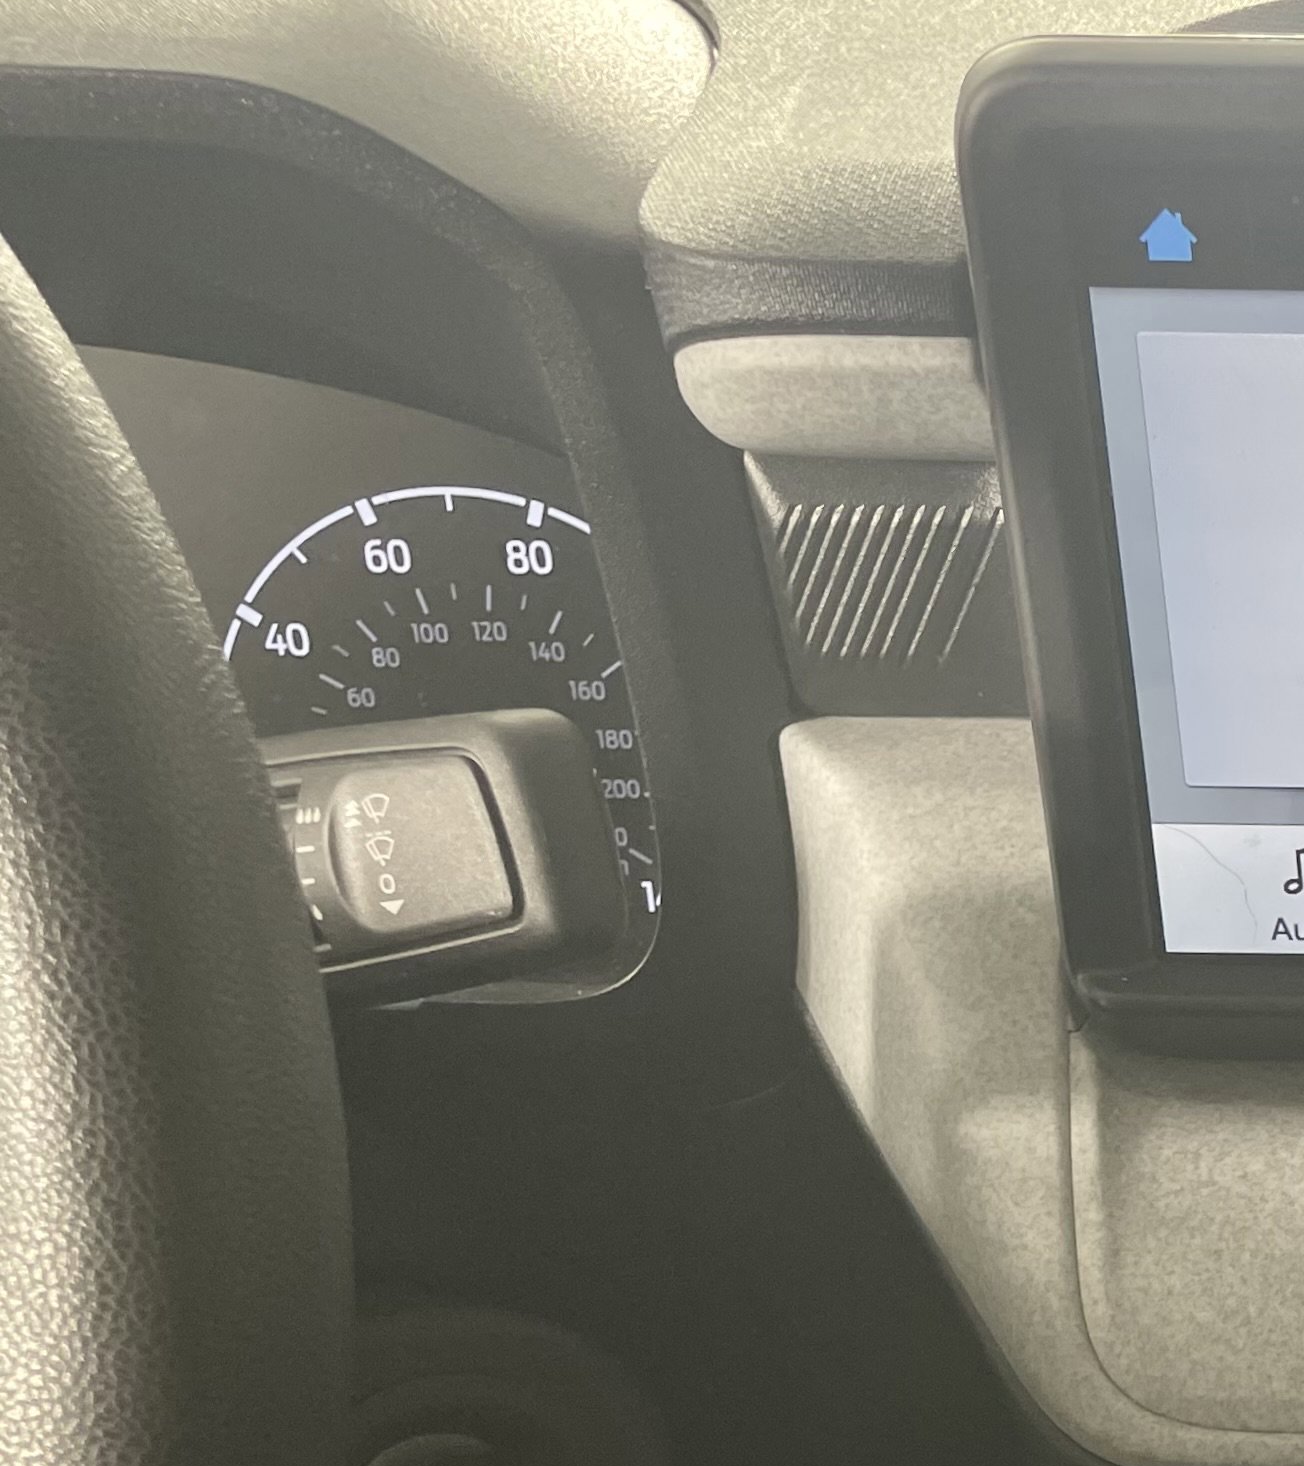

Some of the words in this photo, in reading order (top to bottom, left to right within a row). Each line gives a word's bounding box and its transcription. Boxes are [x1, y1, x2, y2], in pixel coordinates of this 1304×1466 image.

[364, 539, 412, 574] 60
[505, 540, 554, 575] 80
[265, 622, 310, 657] 40
[411, 623, 449, 643] 100
[472, 621, 508, 642] 120
[372, 647, 400, 668] 80
[529, 642, 565, 662] 140
[347, 688, 376, 708] 60
[569, 680, 606, 701] 160
[596, 729, 634, 749] 180
[601, 779, 641, 799] 200
